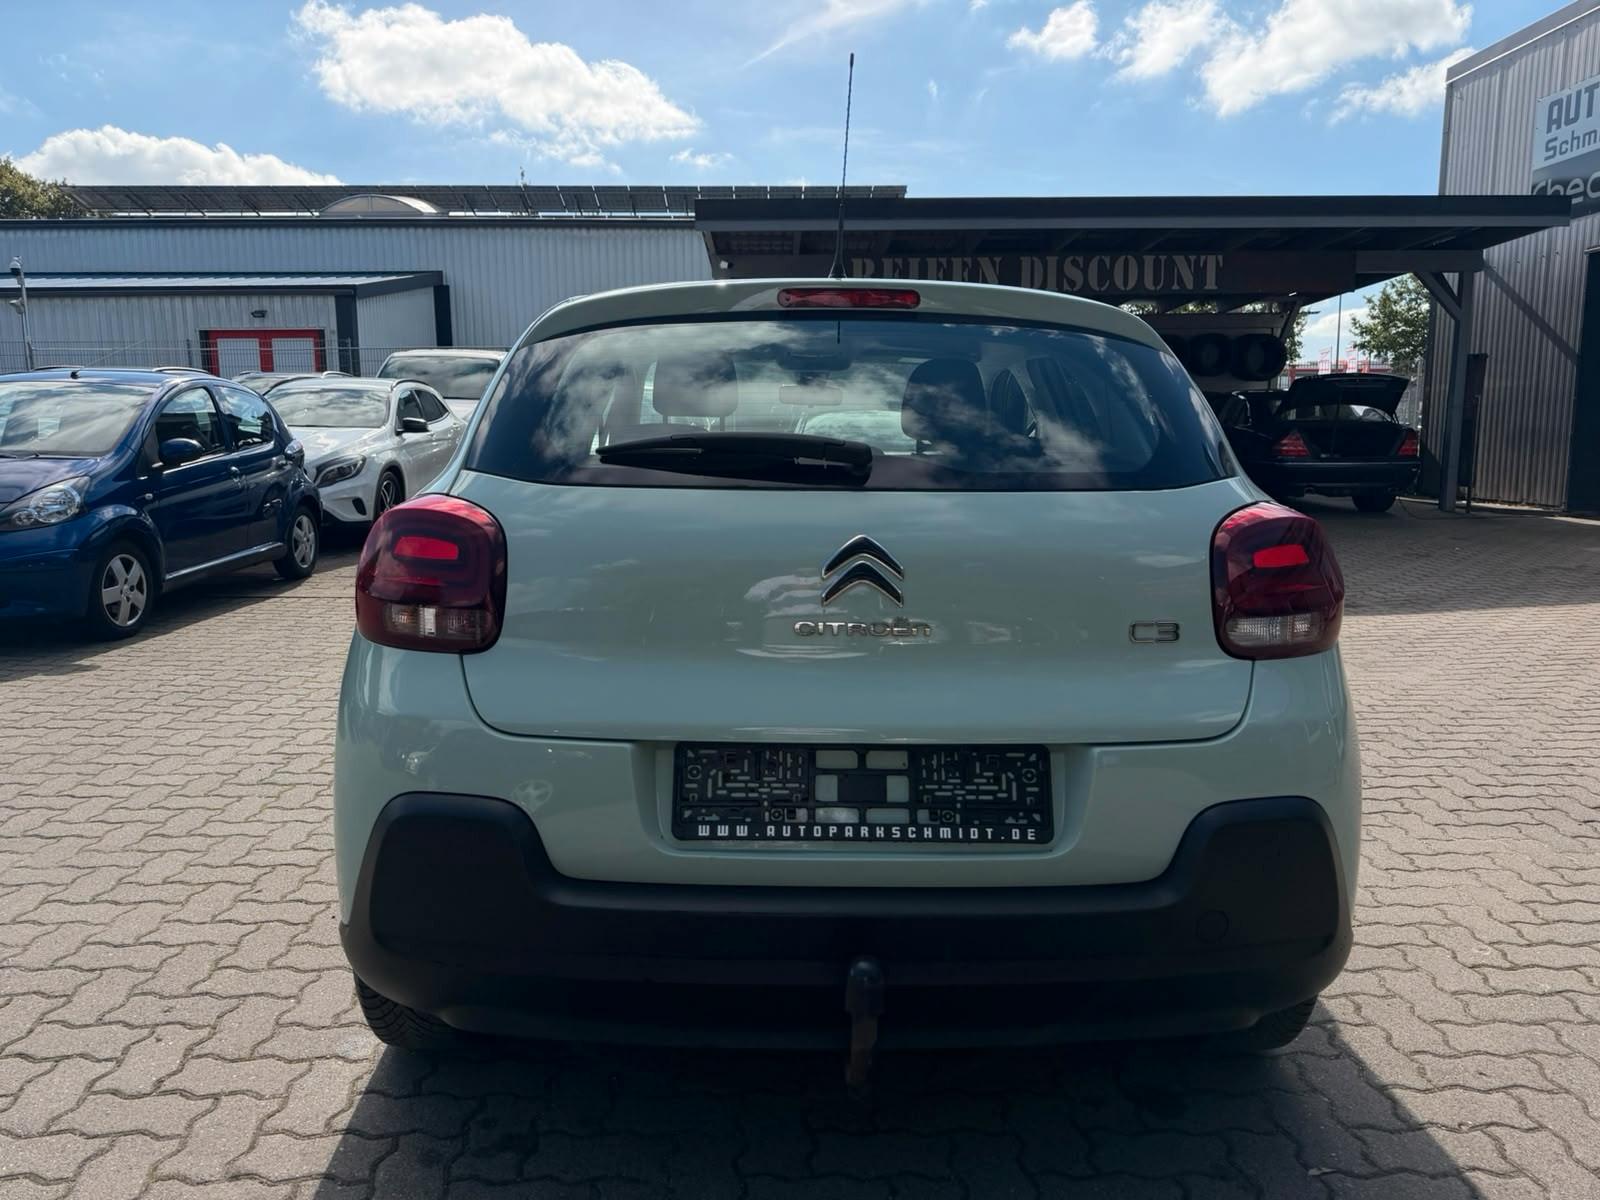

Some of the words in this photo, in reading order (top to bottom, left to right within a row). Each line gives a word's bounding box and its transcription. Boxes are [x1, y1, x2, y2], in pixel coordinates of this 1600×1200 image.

[1544, 130, 1600, 161] Schm
[1020, 255, 1224, 291] DISCOUNT
[1128, 622, 1180, 643] C3
[698, 824, 1036, 841] WWW.AUTOPARKSCHMIDT.DE
